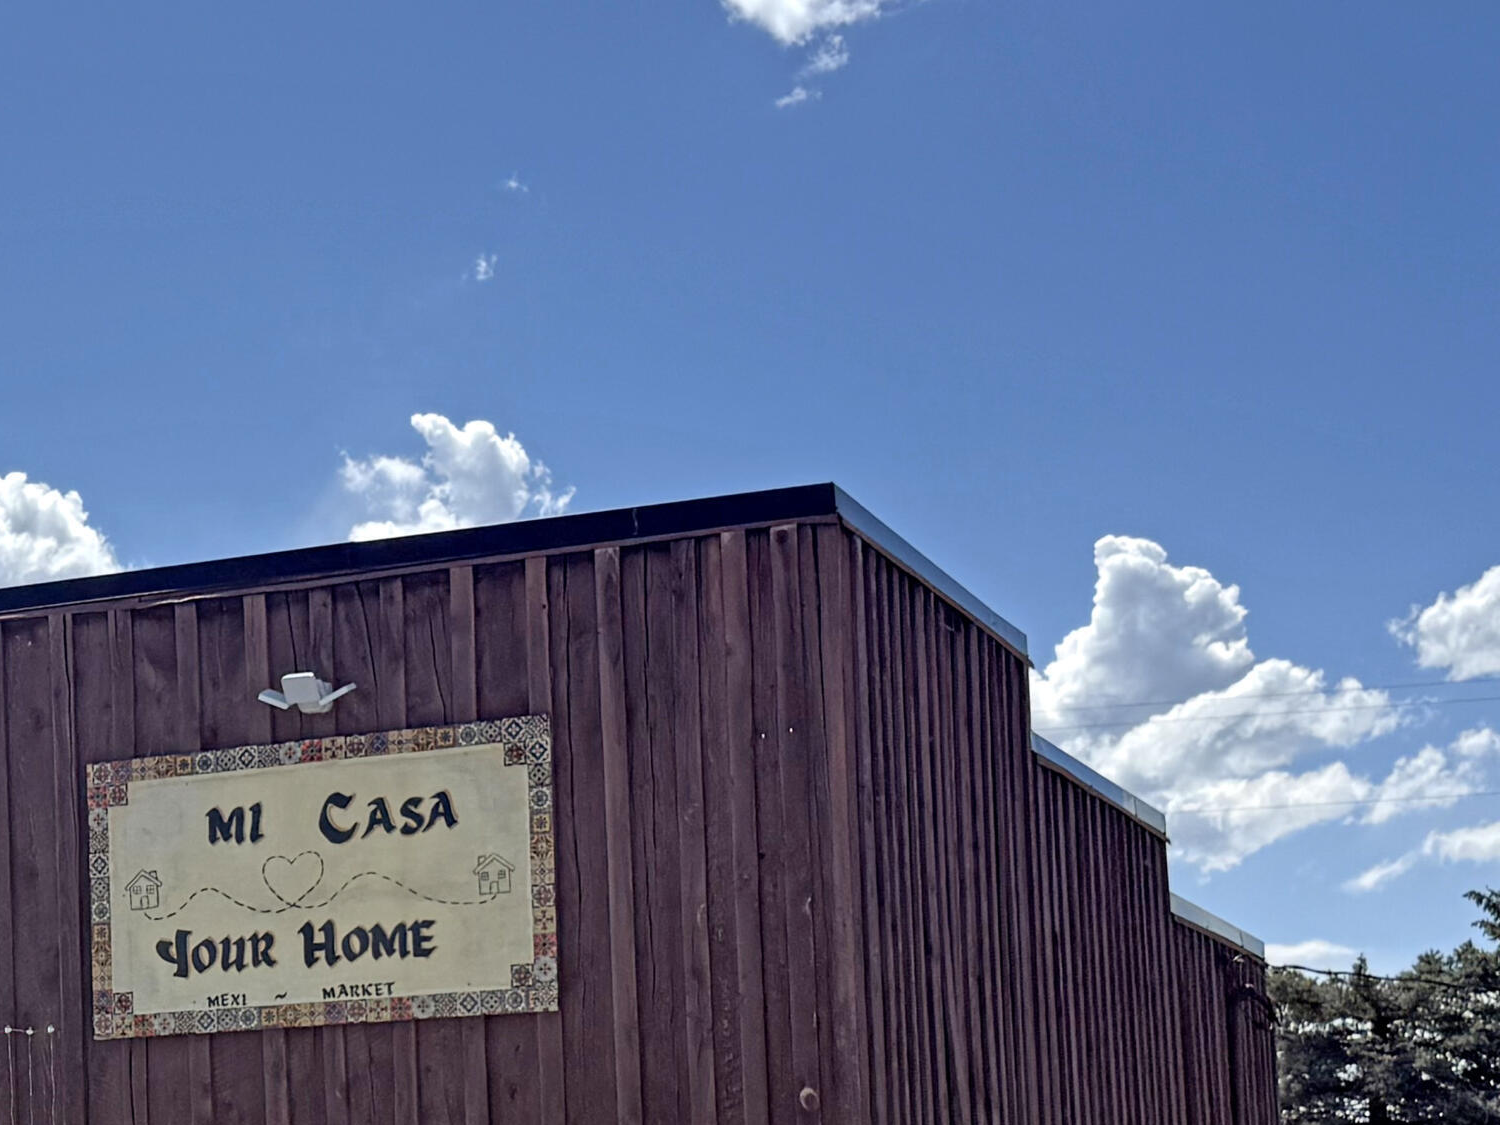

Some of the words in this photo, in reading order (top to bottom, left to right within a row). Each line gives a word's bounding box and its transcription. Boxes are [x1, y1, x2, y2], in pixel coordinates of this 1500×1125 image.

[204, 802, 265, 846] MI
[317, 789, 460, 846] CASA
[297, 918, 438, 969] HOME
[207, 993, 248, 1009] MEXI
[321, 980, 397, 1000] MARKET
